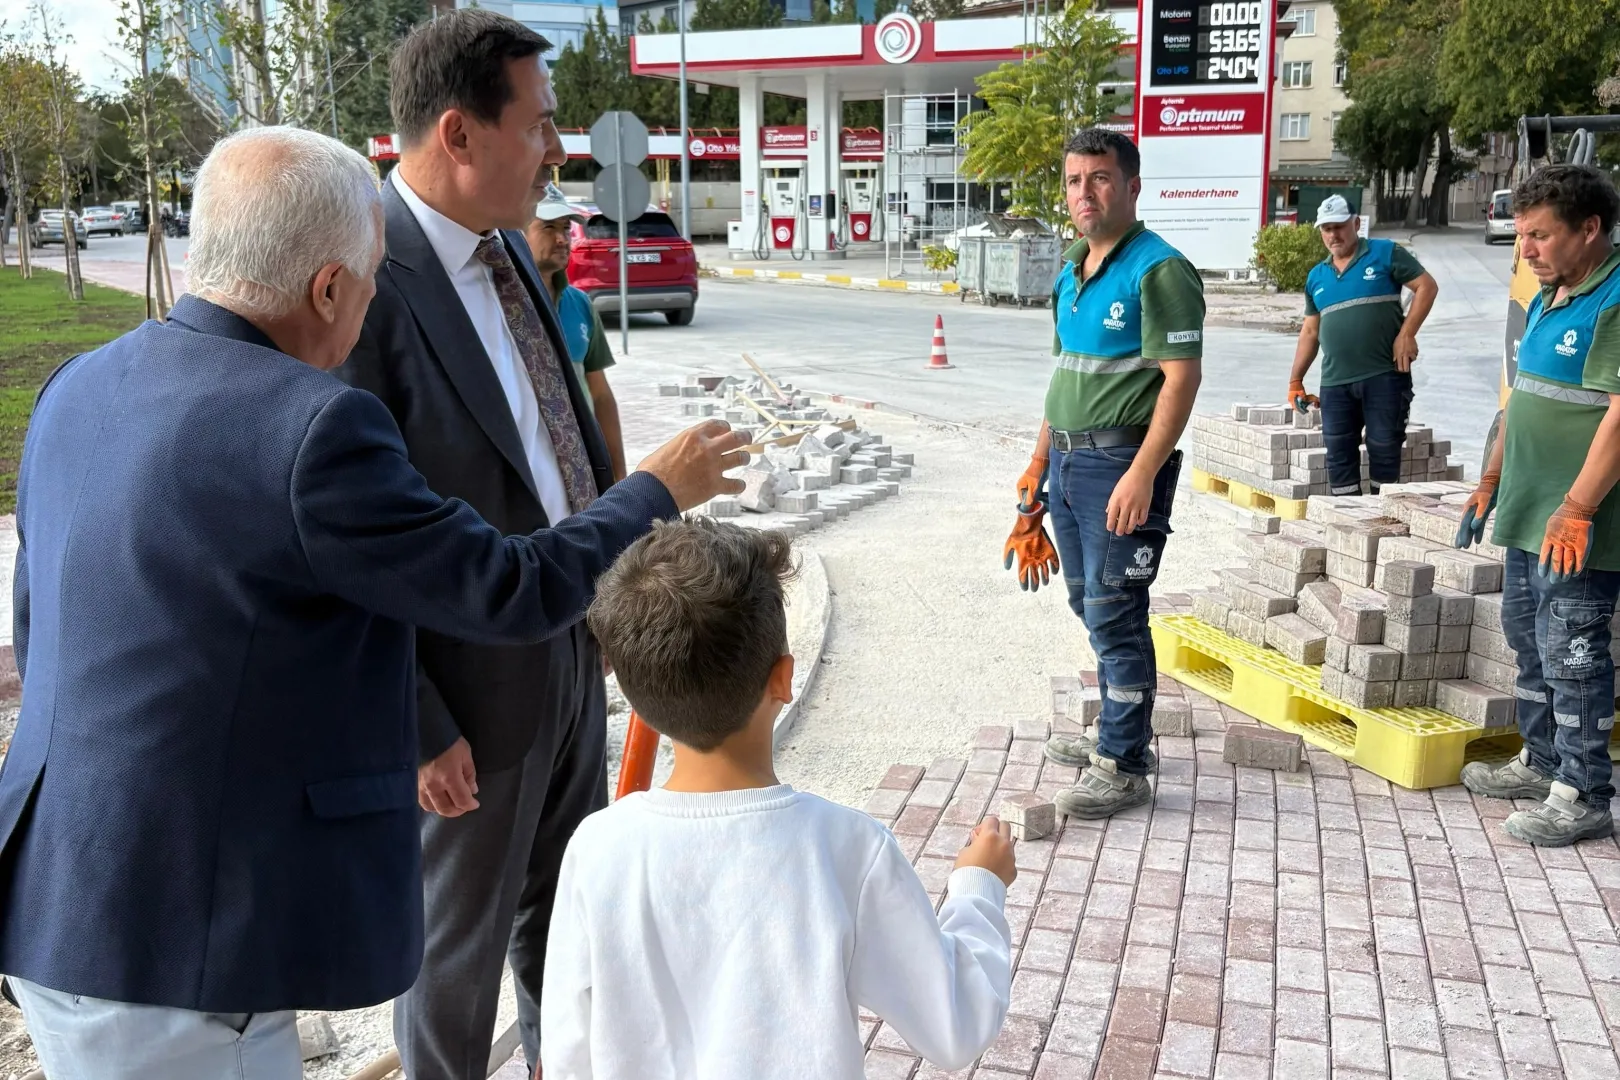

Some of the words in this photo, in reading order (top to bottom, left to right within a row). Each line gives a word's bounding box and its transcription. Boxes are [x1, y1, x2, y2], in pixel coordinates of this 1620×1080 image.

[1160, 9, 1192, 19] Motorin
[1163, 34, 1191, 44] Benzin
[1157, 67, 1172, 75] Oto
[1173, 65, 1189, 75] LPG
[1160, 106, 1245, 126] Optimum
[811, 132, 817, 140] 3
[706, 143, 724, 153] Oto
[1159, 188, 1239, 199] Kalenderhane
[1103, 318, 1126, 329] KARATAY
[1174, 333, 1195, 341] KONYA
[1124, 567, 1154, 576] KARATAY
[1563, 656, 1594, 665] KARATAY
